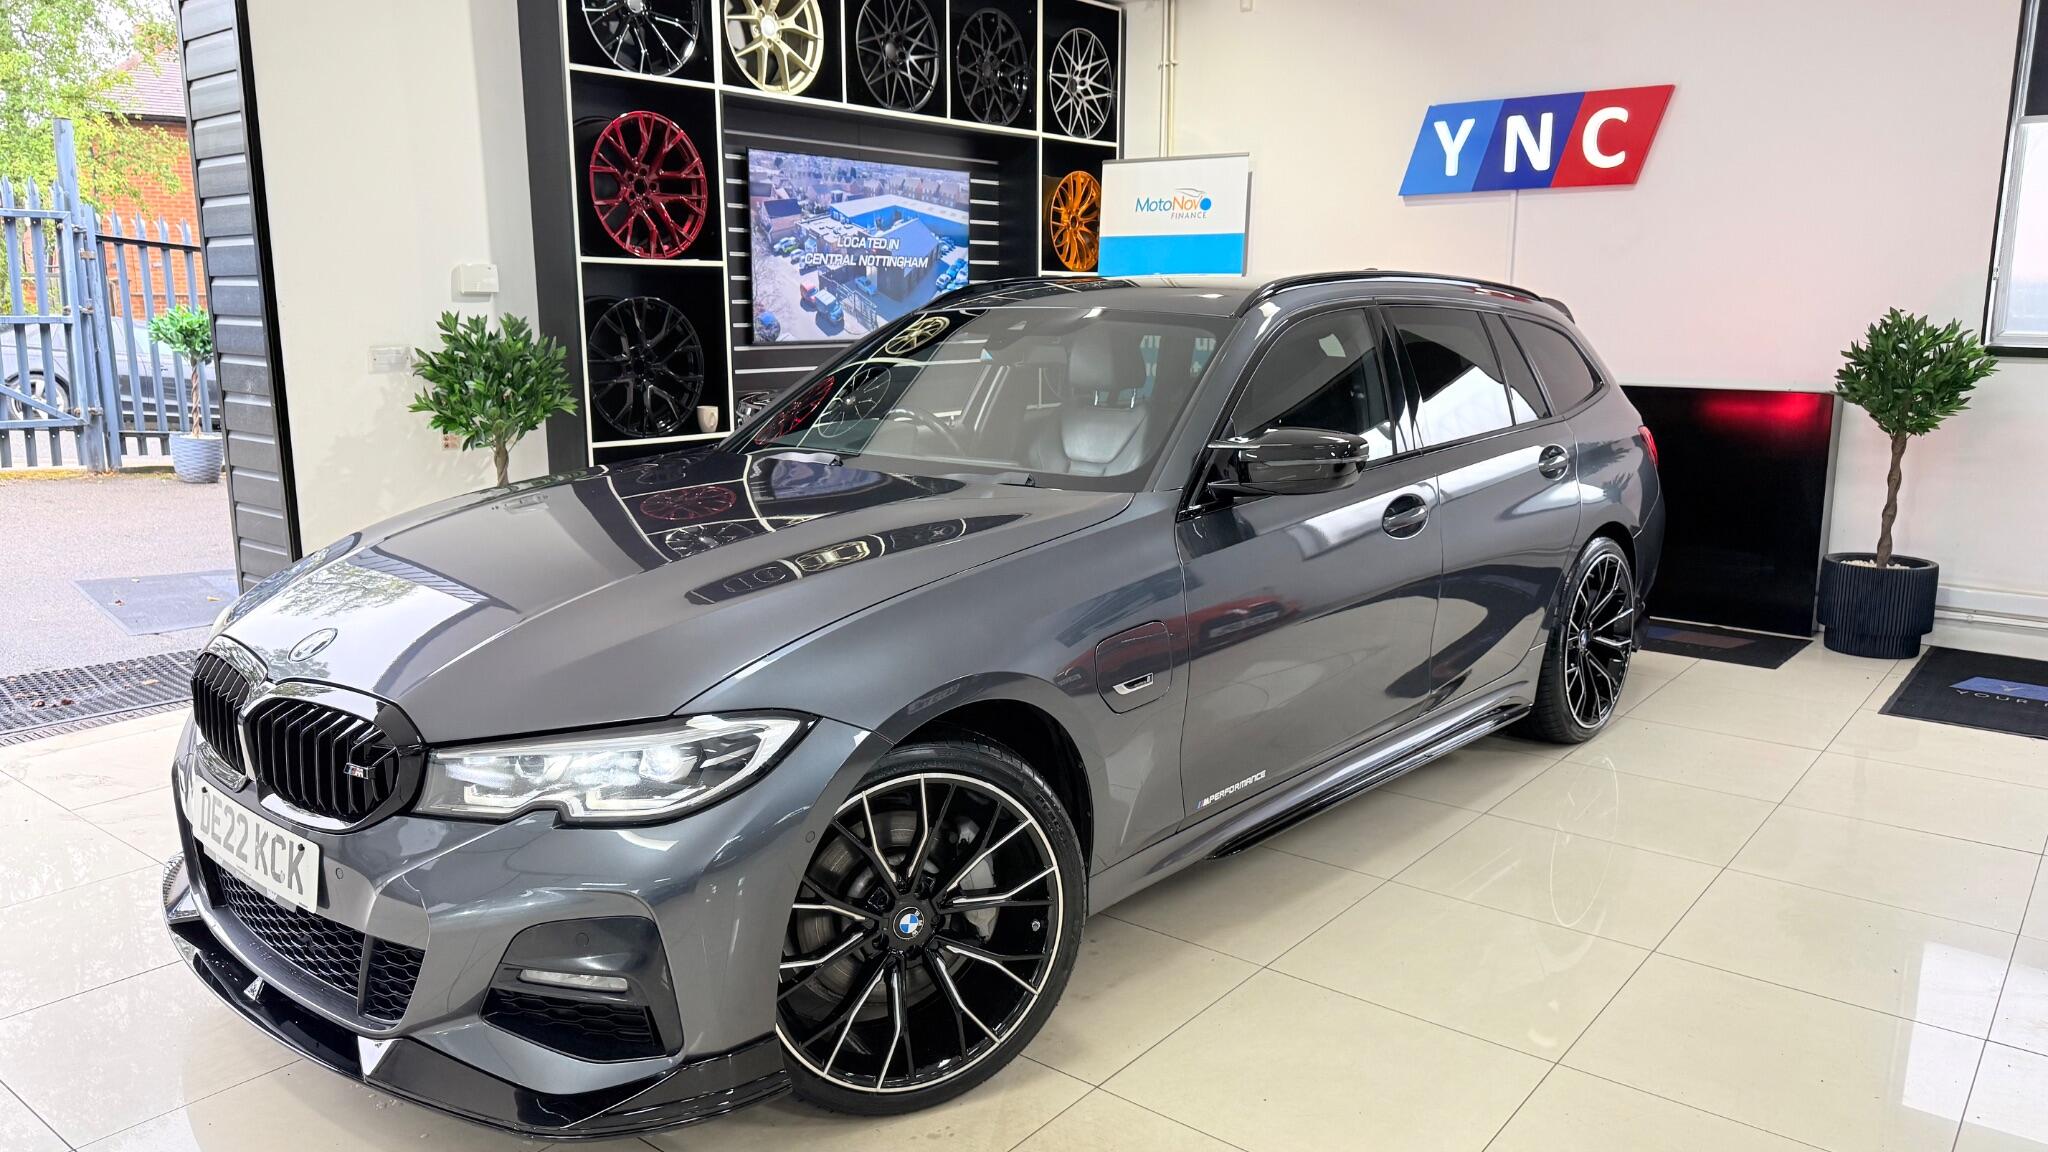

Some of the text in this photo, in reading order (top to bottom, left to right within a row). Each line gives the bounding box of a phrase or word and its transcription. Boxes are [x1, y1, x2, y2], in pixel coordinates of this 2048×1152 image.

[1433, 106, 1629, 177] YNC
[1171, 211, 1207, 219] FINANCE
[837, 236, 900, 250] LOCATED IN
[804, 252, 929, 268] CENTRAL NOTTINGHAM
[1956, 689, 2028, 704] YOUR
[199, 792, 306, 896] DE22 KCK
